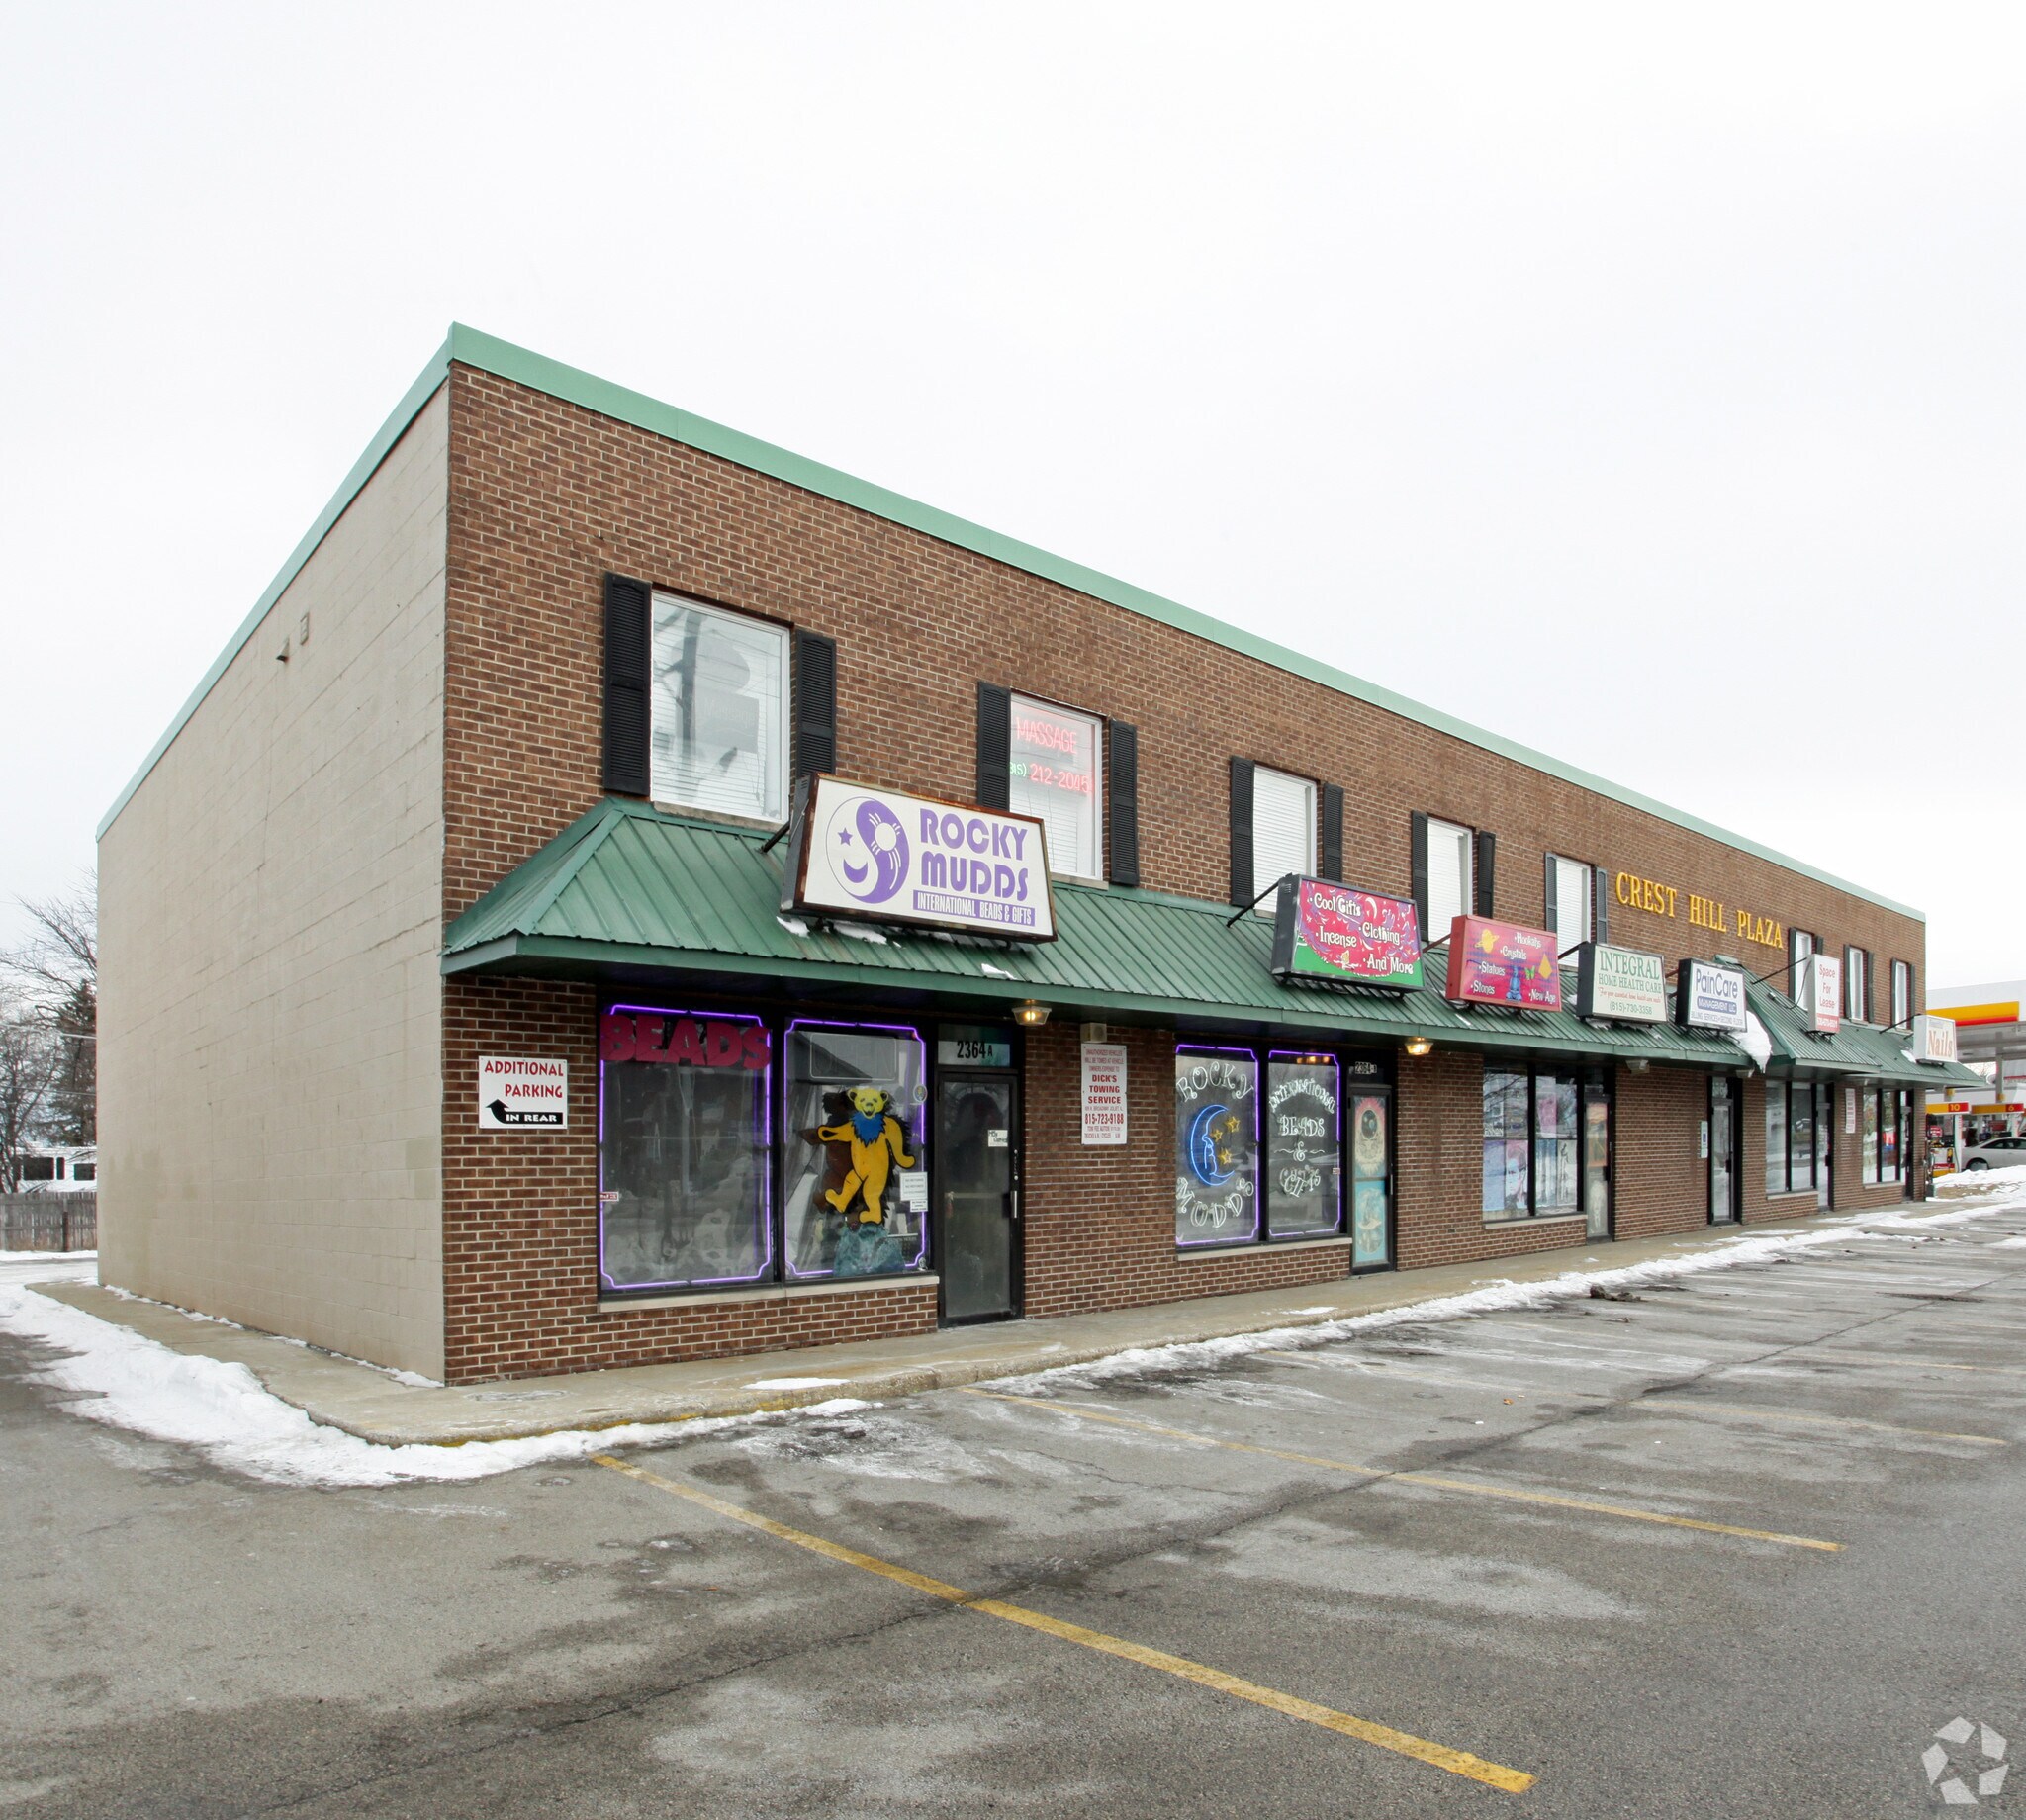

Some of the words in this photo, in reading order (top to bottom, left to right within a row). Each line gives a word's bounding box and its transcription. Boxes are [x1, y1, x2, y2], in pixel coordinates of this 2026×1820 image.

[1016, 716, 1077, 755] MASSAGE
[1030, 763, 1089, 793] 212-2045
[920, 807, 1028, 861] ROCKY
[921, 851, 1029, 901] MUDDS
[917, 891, 976, 916] INTERNATIONAL
[979, 901, 1002, 921] BEADS
[1004, 908, 1010, 922] &
[1012, 908, 1032, 925] GIFTS
[1314, 892, 1336, 912] Cool
[1337, 895, 1361, 917] Gifts
[1615, 871, 1678, 918] CREST
[1689, 894, 1727, 933] HILL
[1736, 909, 1784, 950] PLAZA
[1320, 925, 1357, 947] Incense
[1362, 922, 1400, 945] Clothing
[1502, 945, 1526, 960] Crystals
[1367, 954, 1387, 971] And
[1389, 956, 1414, 974] More
[1481, 961, 1506, 976] Statues
[1600, 950, 1659, 980] INTEGRAL
[1819, 964, 1836, 979] Space
[1473, 980, 1495, 995] Stones
[1599, 973, 1617, 987] HOME
[1618, 977, 1644, 991] HEALTH
[1645, 981, 1662, 993] CARE
[1696, 968, 1738, 999] PainCare
[1530, 988, 1543, 1001] New
[1544, 991, 1556, 1004] Age
[1819, 996, 1836, 1009] Lease
[600, 1013, 773, 1070] BEADS
[1927, 1030, 1953, 1057] Nails
[484, 1060, 564, 1077] ADDITIONAL
[1092, 1074, 1117, 1083] DICK'S
[505, 1084, 563, 1098] PARKING
[1176, 1061, 1253, 1103] ROCKY
[1269, 1078, 1336, 1114] INTERNATIONAL
[1084, 1113, 1124, 1124] 815-723-9188
[1280, 1115, 1325, 1137] BEADS
[1294, 1141, 1306, 1161] &
[1281, 1168, 1322, 1198] GIFTS
